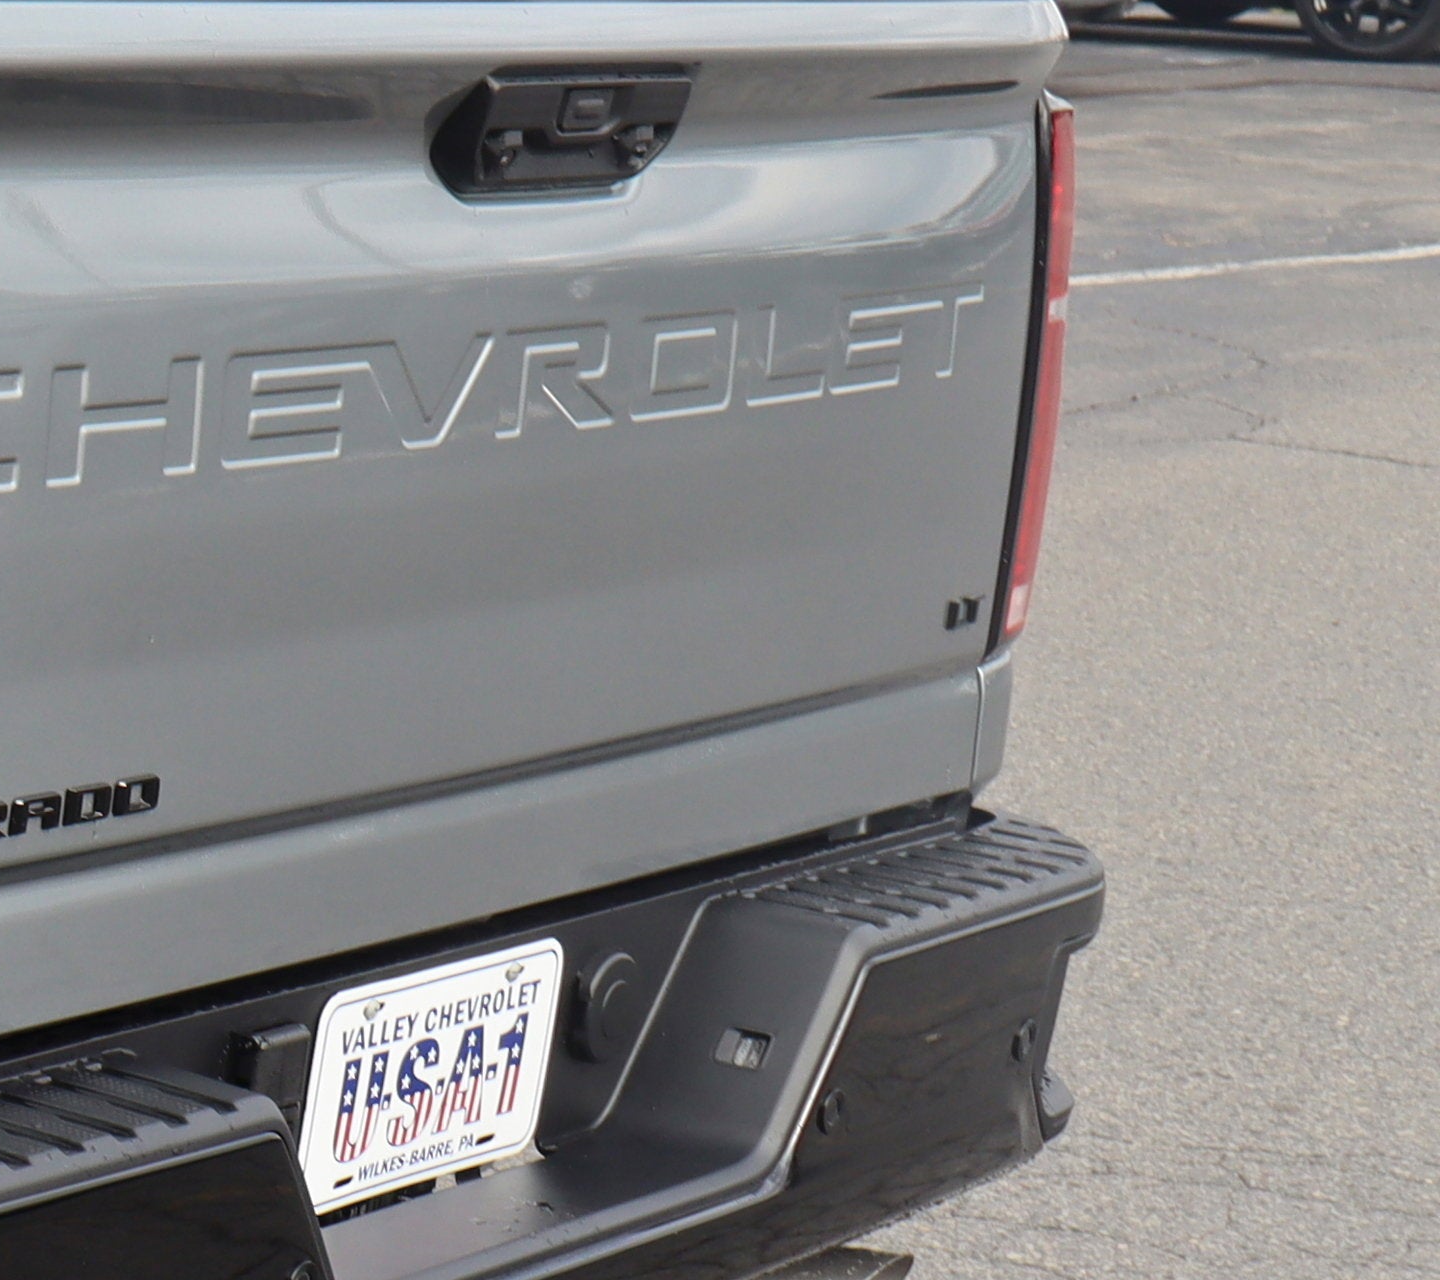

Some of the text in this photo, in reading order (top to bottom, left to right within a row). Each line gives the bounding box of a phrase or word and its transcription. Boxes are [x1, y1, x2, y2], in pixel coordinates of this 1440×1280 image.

[342, 979, 542, 1056] VALLEY CHEVROLET
[458, 1133, 476, 1151] PA
